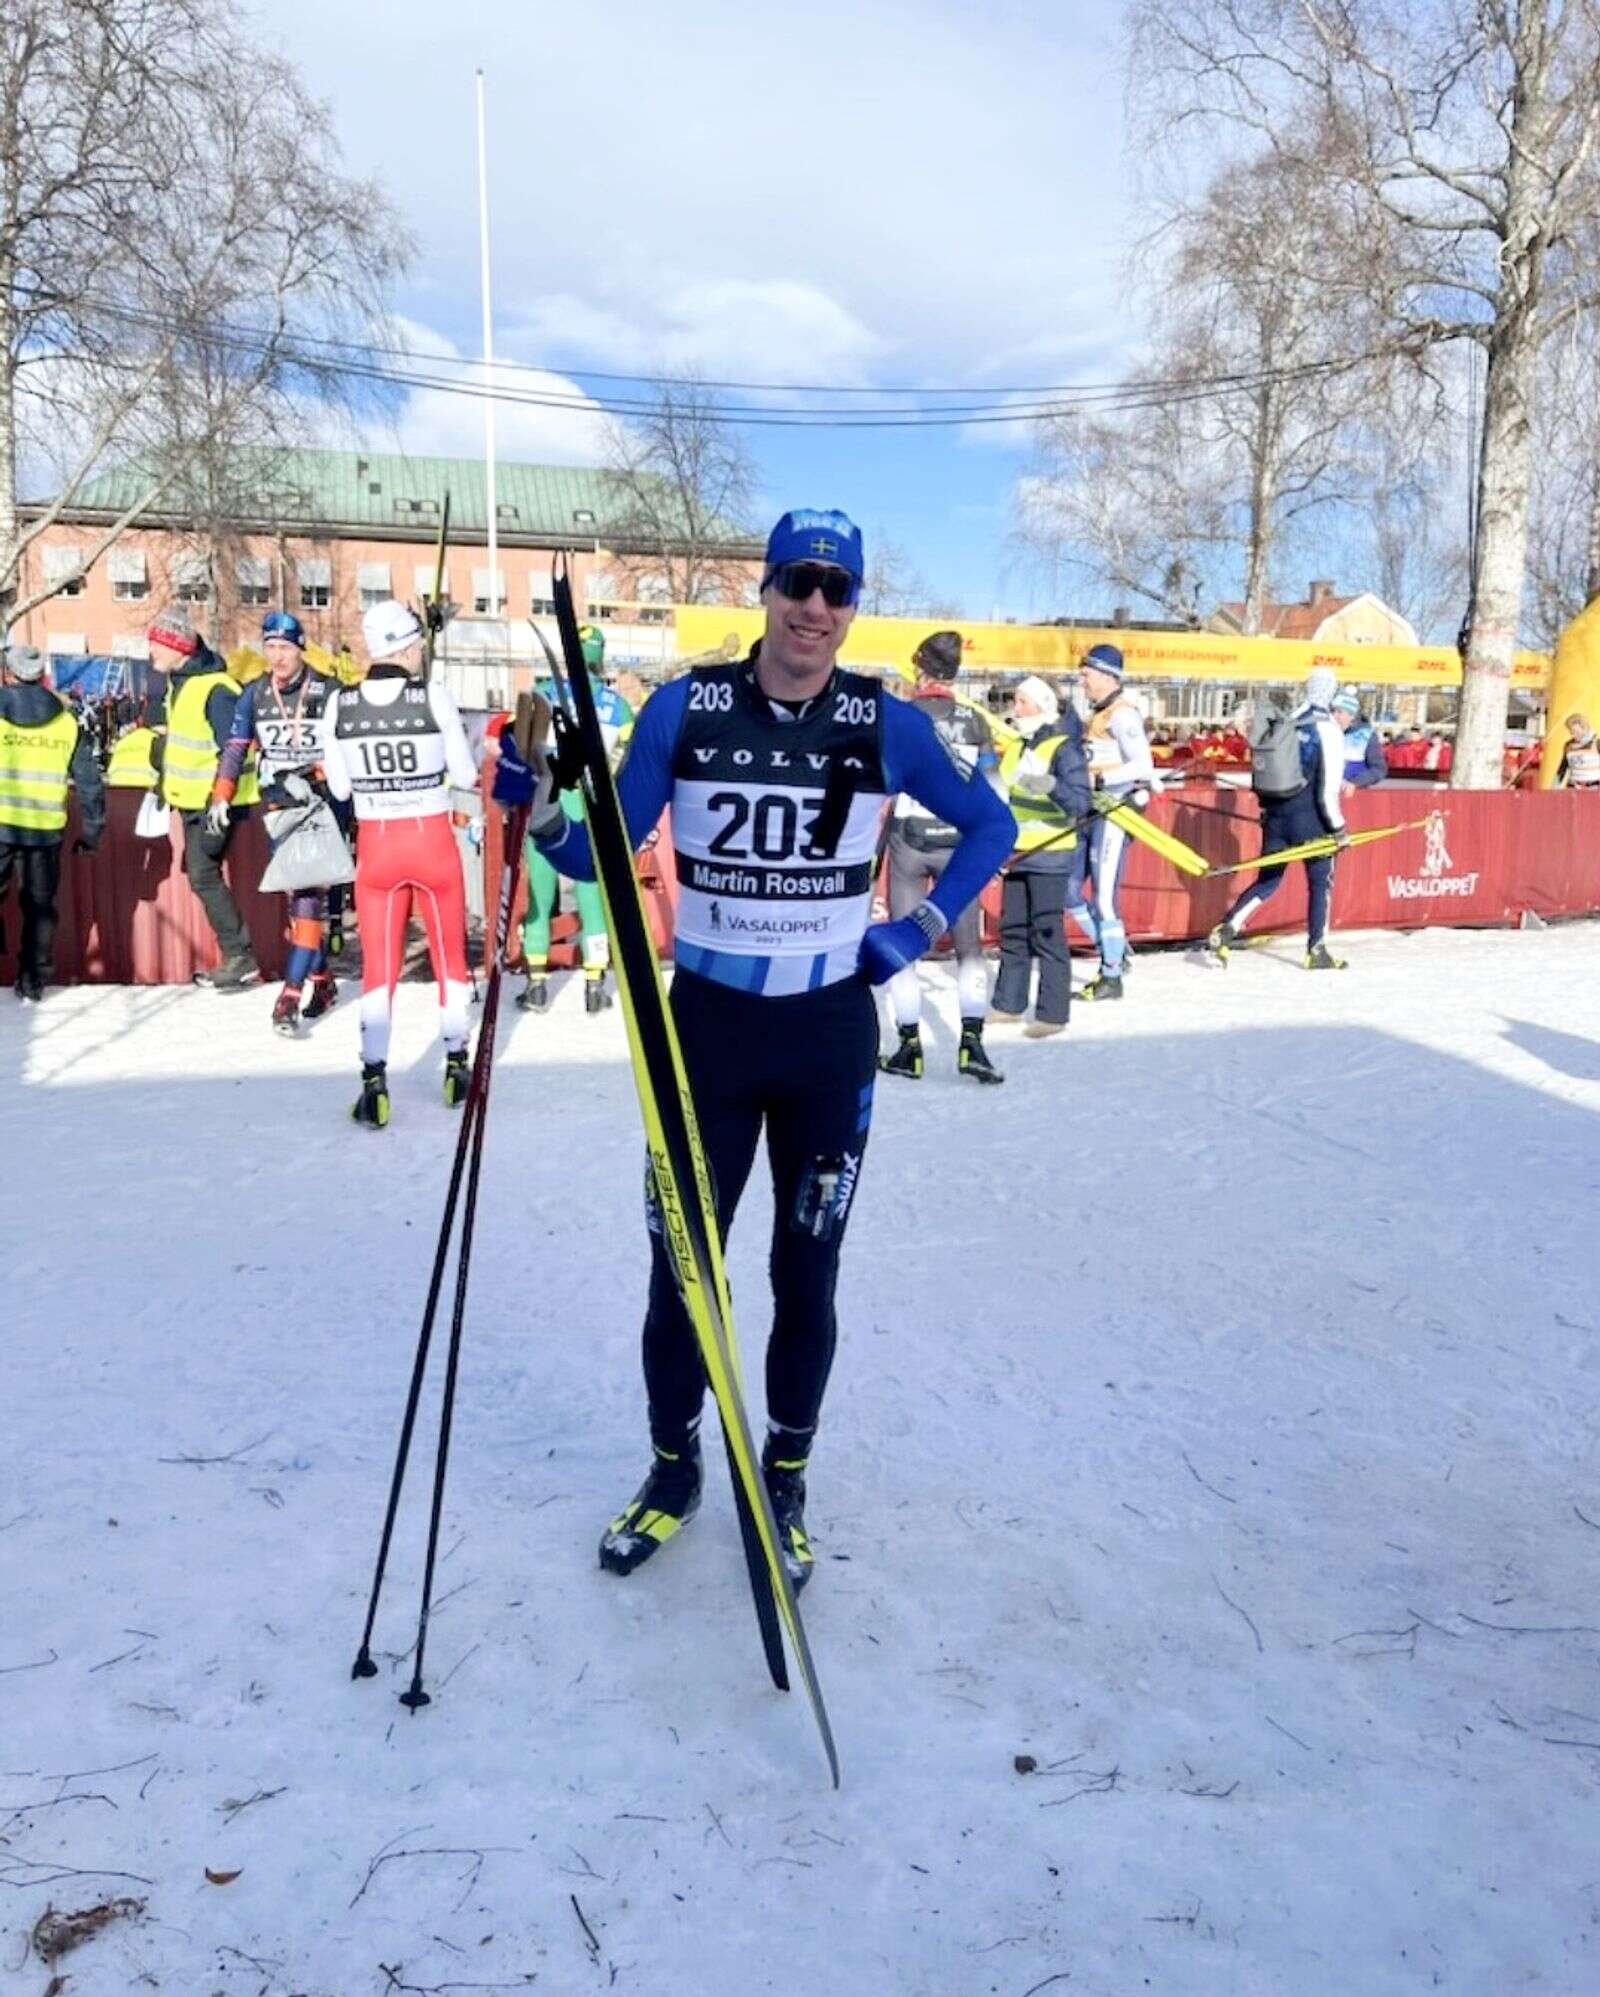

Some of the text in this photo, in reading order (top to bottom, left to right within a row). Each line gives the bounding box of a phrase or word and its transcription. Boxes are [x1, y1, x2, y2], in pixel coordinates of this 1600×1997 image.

[689, 681, 734, 712] 203
[832, 692, 877, 725] 203
[265, 723, 317, 747] 223
[342, 718, 426, 732] VOLVO
[357, 741, 418, 776] 188
[693, 863, 846, 894] Martin Rosvall
[1387, 872, 1480, 899] VASALOPPET
[727, 914, 831, 933] VASALOPPET
[681, 1088, 716, 1218] FISCHER
[653, 1149, 698, 1284] FISCHER
